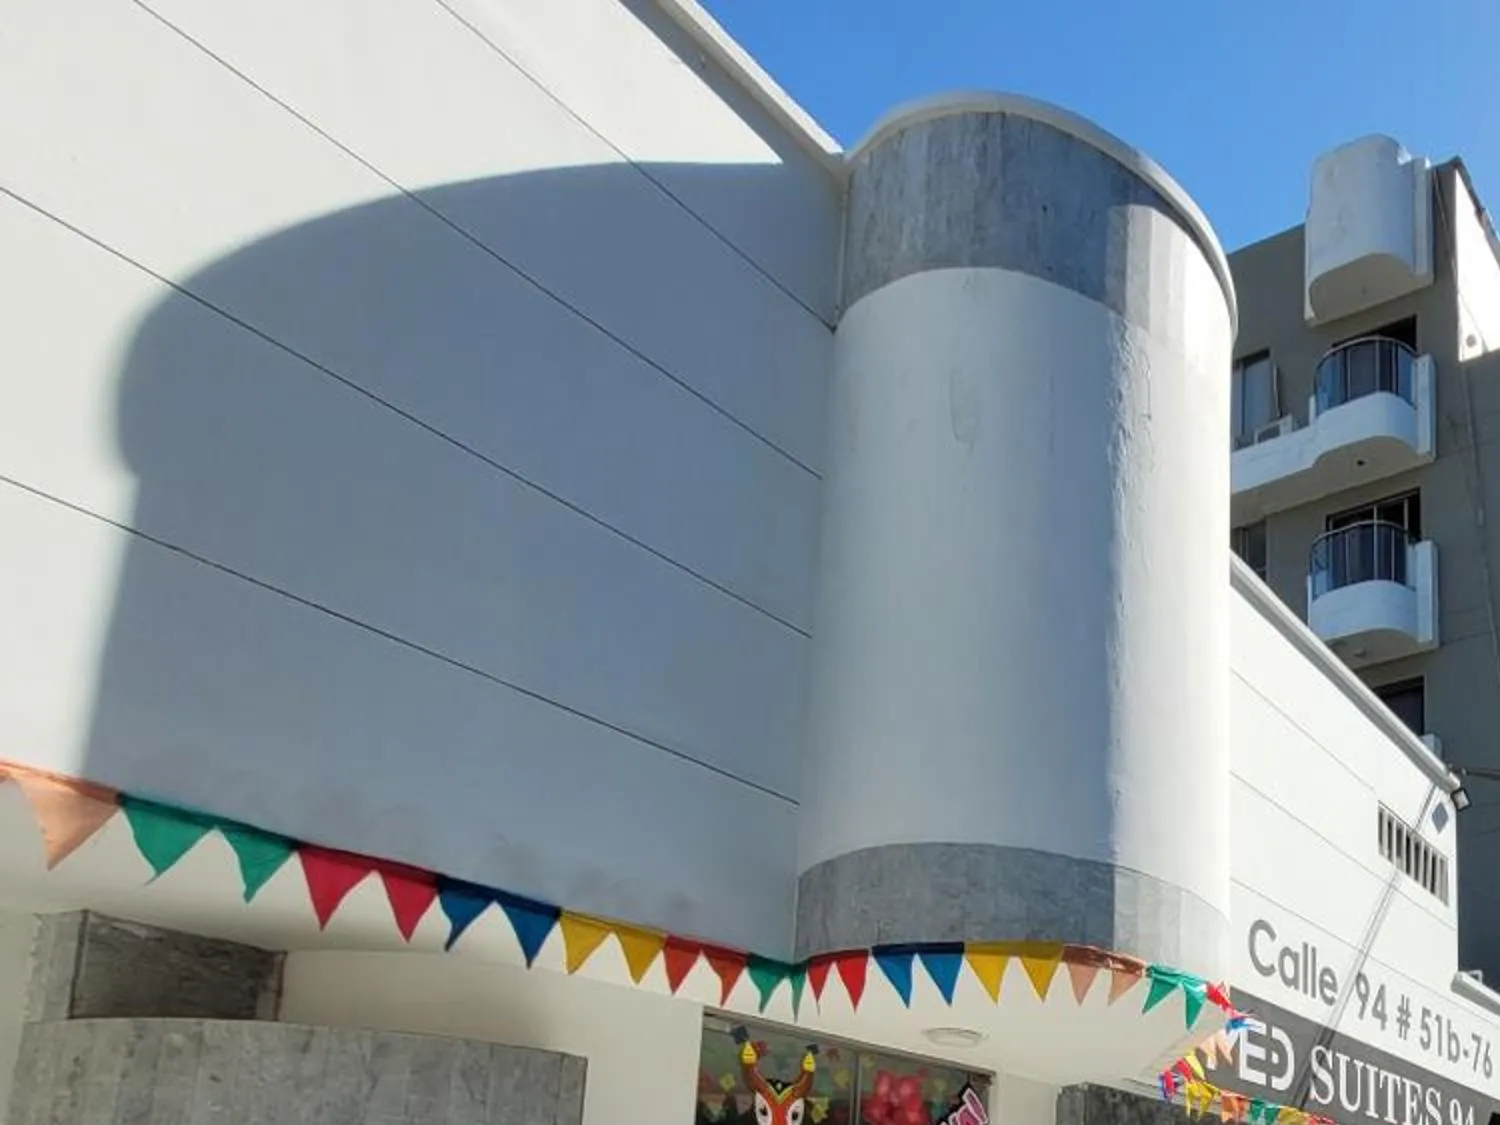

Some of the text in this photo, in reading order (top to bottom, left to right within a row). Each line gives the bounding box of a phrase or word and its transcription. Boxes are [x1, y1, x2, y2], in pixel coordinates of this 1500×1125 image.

[1247, 919, 1493, 1079] Calle 94 # 51b-76
